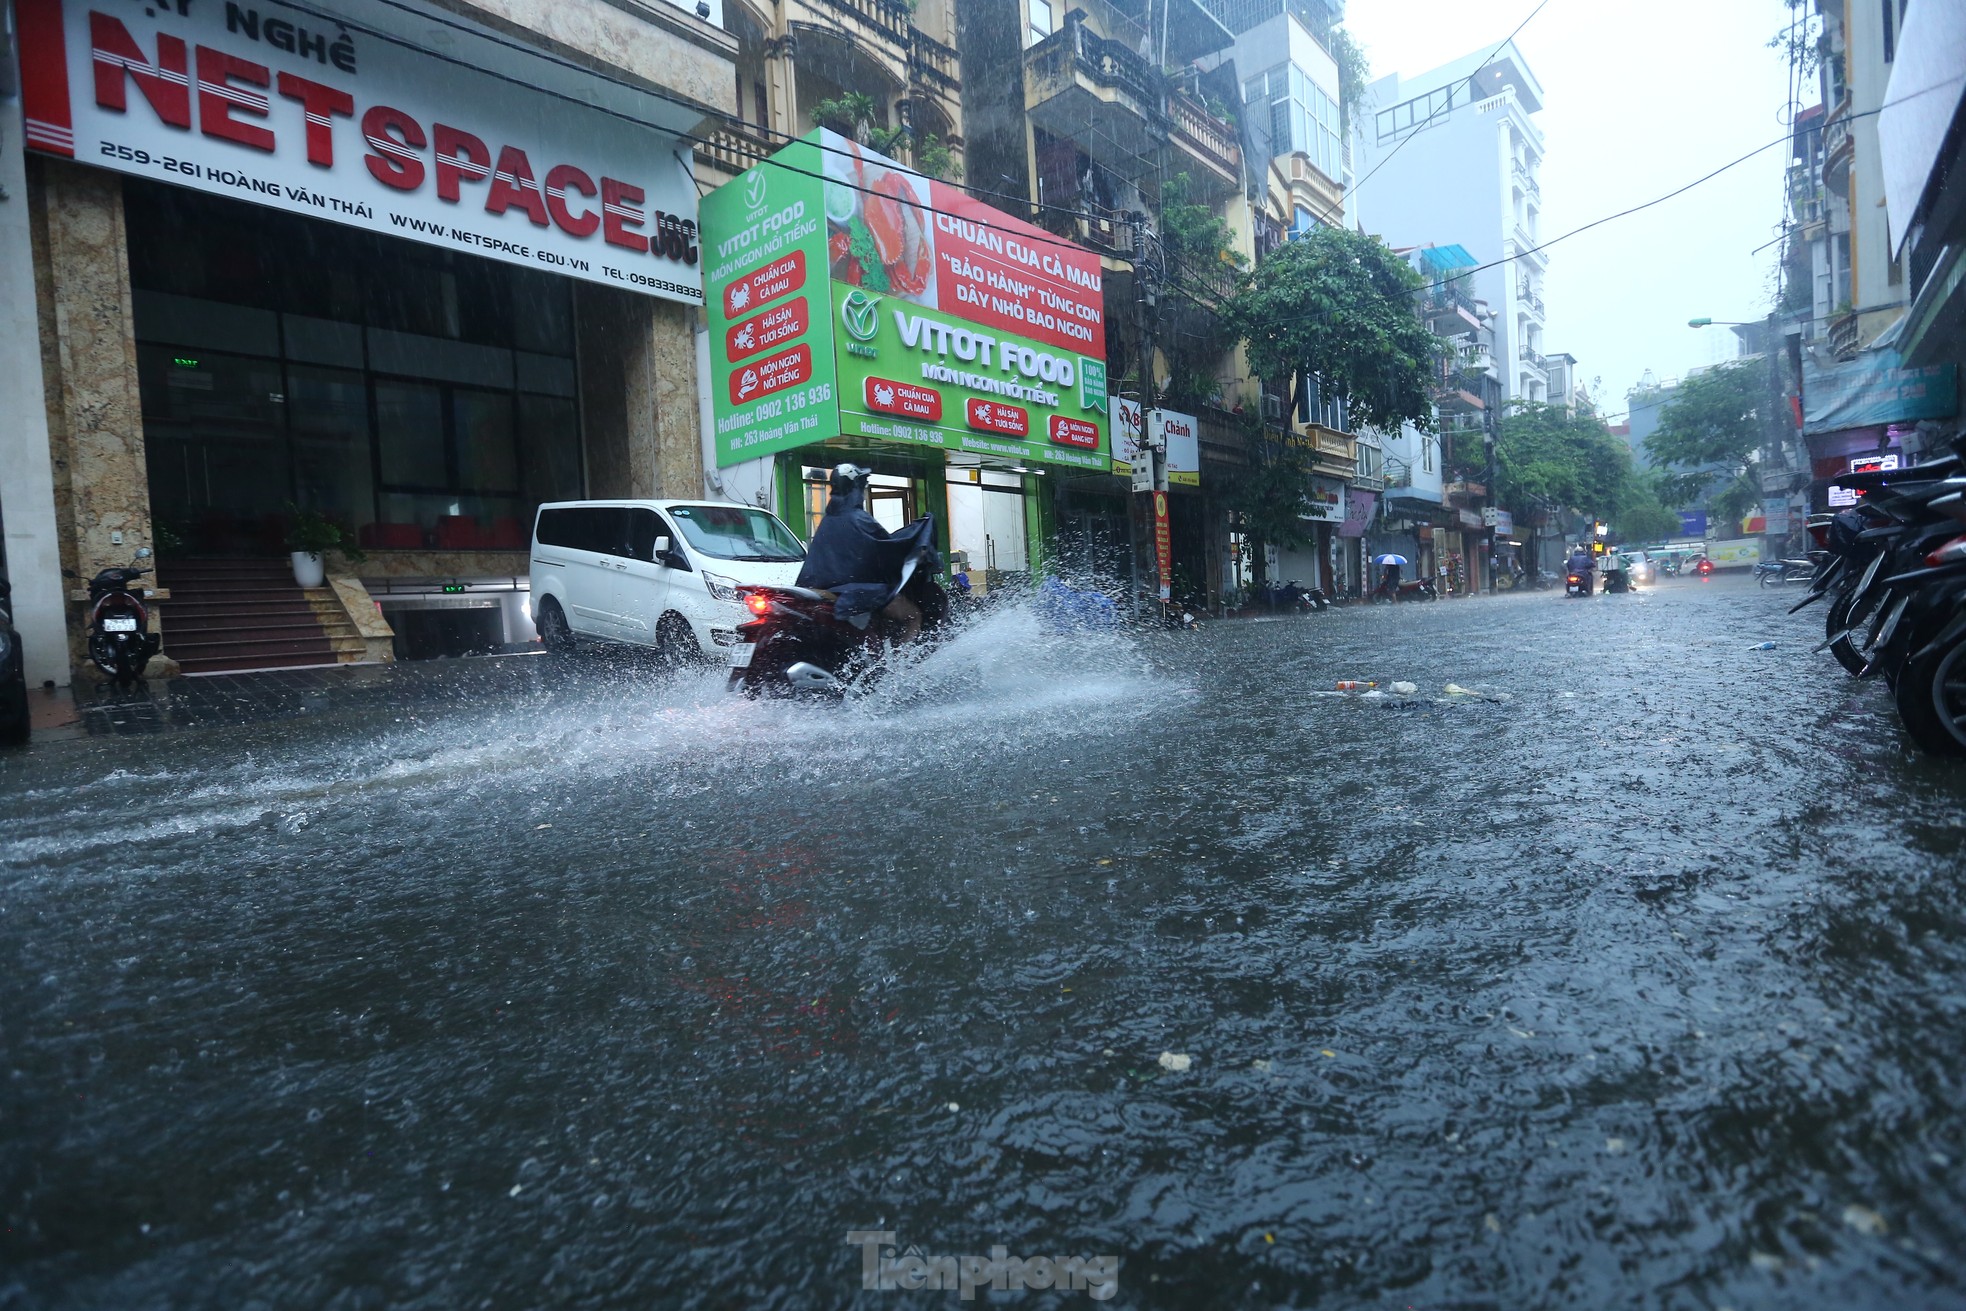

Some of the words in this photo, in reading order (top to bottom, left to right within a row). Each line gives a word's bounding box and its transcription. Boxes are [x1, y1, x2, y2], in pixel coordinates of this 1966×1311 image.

[90, 9, 648, 253] NETSPACE
[100, 141, 201, 178] 259-261
[207, 168, 281, 197] HOÀNG
[285, 186, 325, 208] VĂN
[330, 197, 373, 219] THÁI
[746, 205, 768, 222] VITOT
[718, 224, 759, 258] VITOT
[762, 200, 805, 236] FOOD
[711, 261, 733, 283] MÓN
[734, 246, 763, 270] NGON
[764, 231, 783, 255] NỔI
[784, 218, 817, 245] TIẾNG
[936, 213, 1003, 255] CHUẨN
[1005, 240, 1041, 270] CUA
[1042, 253, 1064, 279] CÀ
[1066, 264, 1102, 293] MAU
[753, 264, 780, 287] CHUẨN
[780, 260, 796, 275] CUA
[760, 285, 771, 299] CÀ
[771, 278, 789, 295] MAU
[956, 284, 990, 309] DÂY
[992, 296, 1025, 321] NHỎ
[1026, 308, 1055, 331] BAO
[1057, 318, 1093, 342] NGON
[1037, 288, 1074, 314] TỪNG
[1075, 303, 1101, 324] CON
[762, 313, 775, 329] HẢI
[776, 308, 792, 323] SẢN
[759, 330, 777, 345] TƯƠI
[778, 321, 799, 339] SỐNG
[893, 310, 996, 367] VITOT
[1000, 341, 1075, 388] FOOD
[760, 360, 778, 377] MÓN
[778, 353, 801, 368] NGON
[1084, 364, 1104, 379] 100%
[763, 370, 777, 390] NỔI
[778, 368, 800, 384] TIẾNG
[921, 360, 959, 386] MÓN
[959, 370, 1001, 394] NGON
[1000, 375, 1025, 399] NỔI
[1024, 381, 1060, 407] TIẾNG
[897, 387, 921, 400] CHUẨN
[922, 393, 935, 403] CUA
[903, 400, 913, 411] CÀ
[915, 403, 930, 414] MAU
[718, 411, 754, 434] Hotline:
[756, 399, 782, 422] 0902
[785, 391, 806, 413] 136
[808, 383, 831, 406] 936
[997, 407, 1007, 418] HẢI
[1007, 408, 1019, 419] SẢN
[744, 430, 758, 447] 263
[760, 427, 783, 442] Hoàng
[784, 421, 799, 435] Văn
[800, 414, 818, 429] Thái
[860, 421, 891, 436] Hotline:
[893, 424, 912, 439] 0902
[914, 429, 928, 441] 136
[929, 432, 944, 443] 936
[1009, 418, 1024, 431] SỐNG
[1165, 420, 1190, 438] Chảnh
[961, 437, 990, 450] Website:
[1055, 450, 1065, 460] 263
